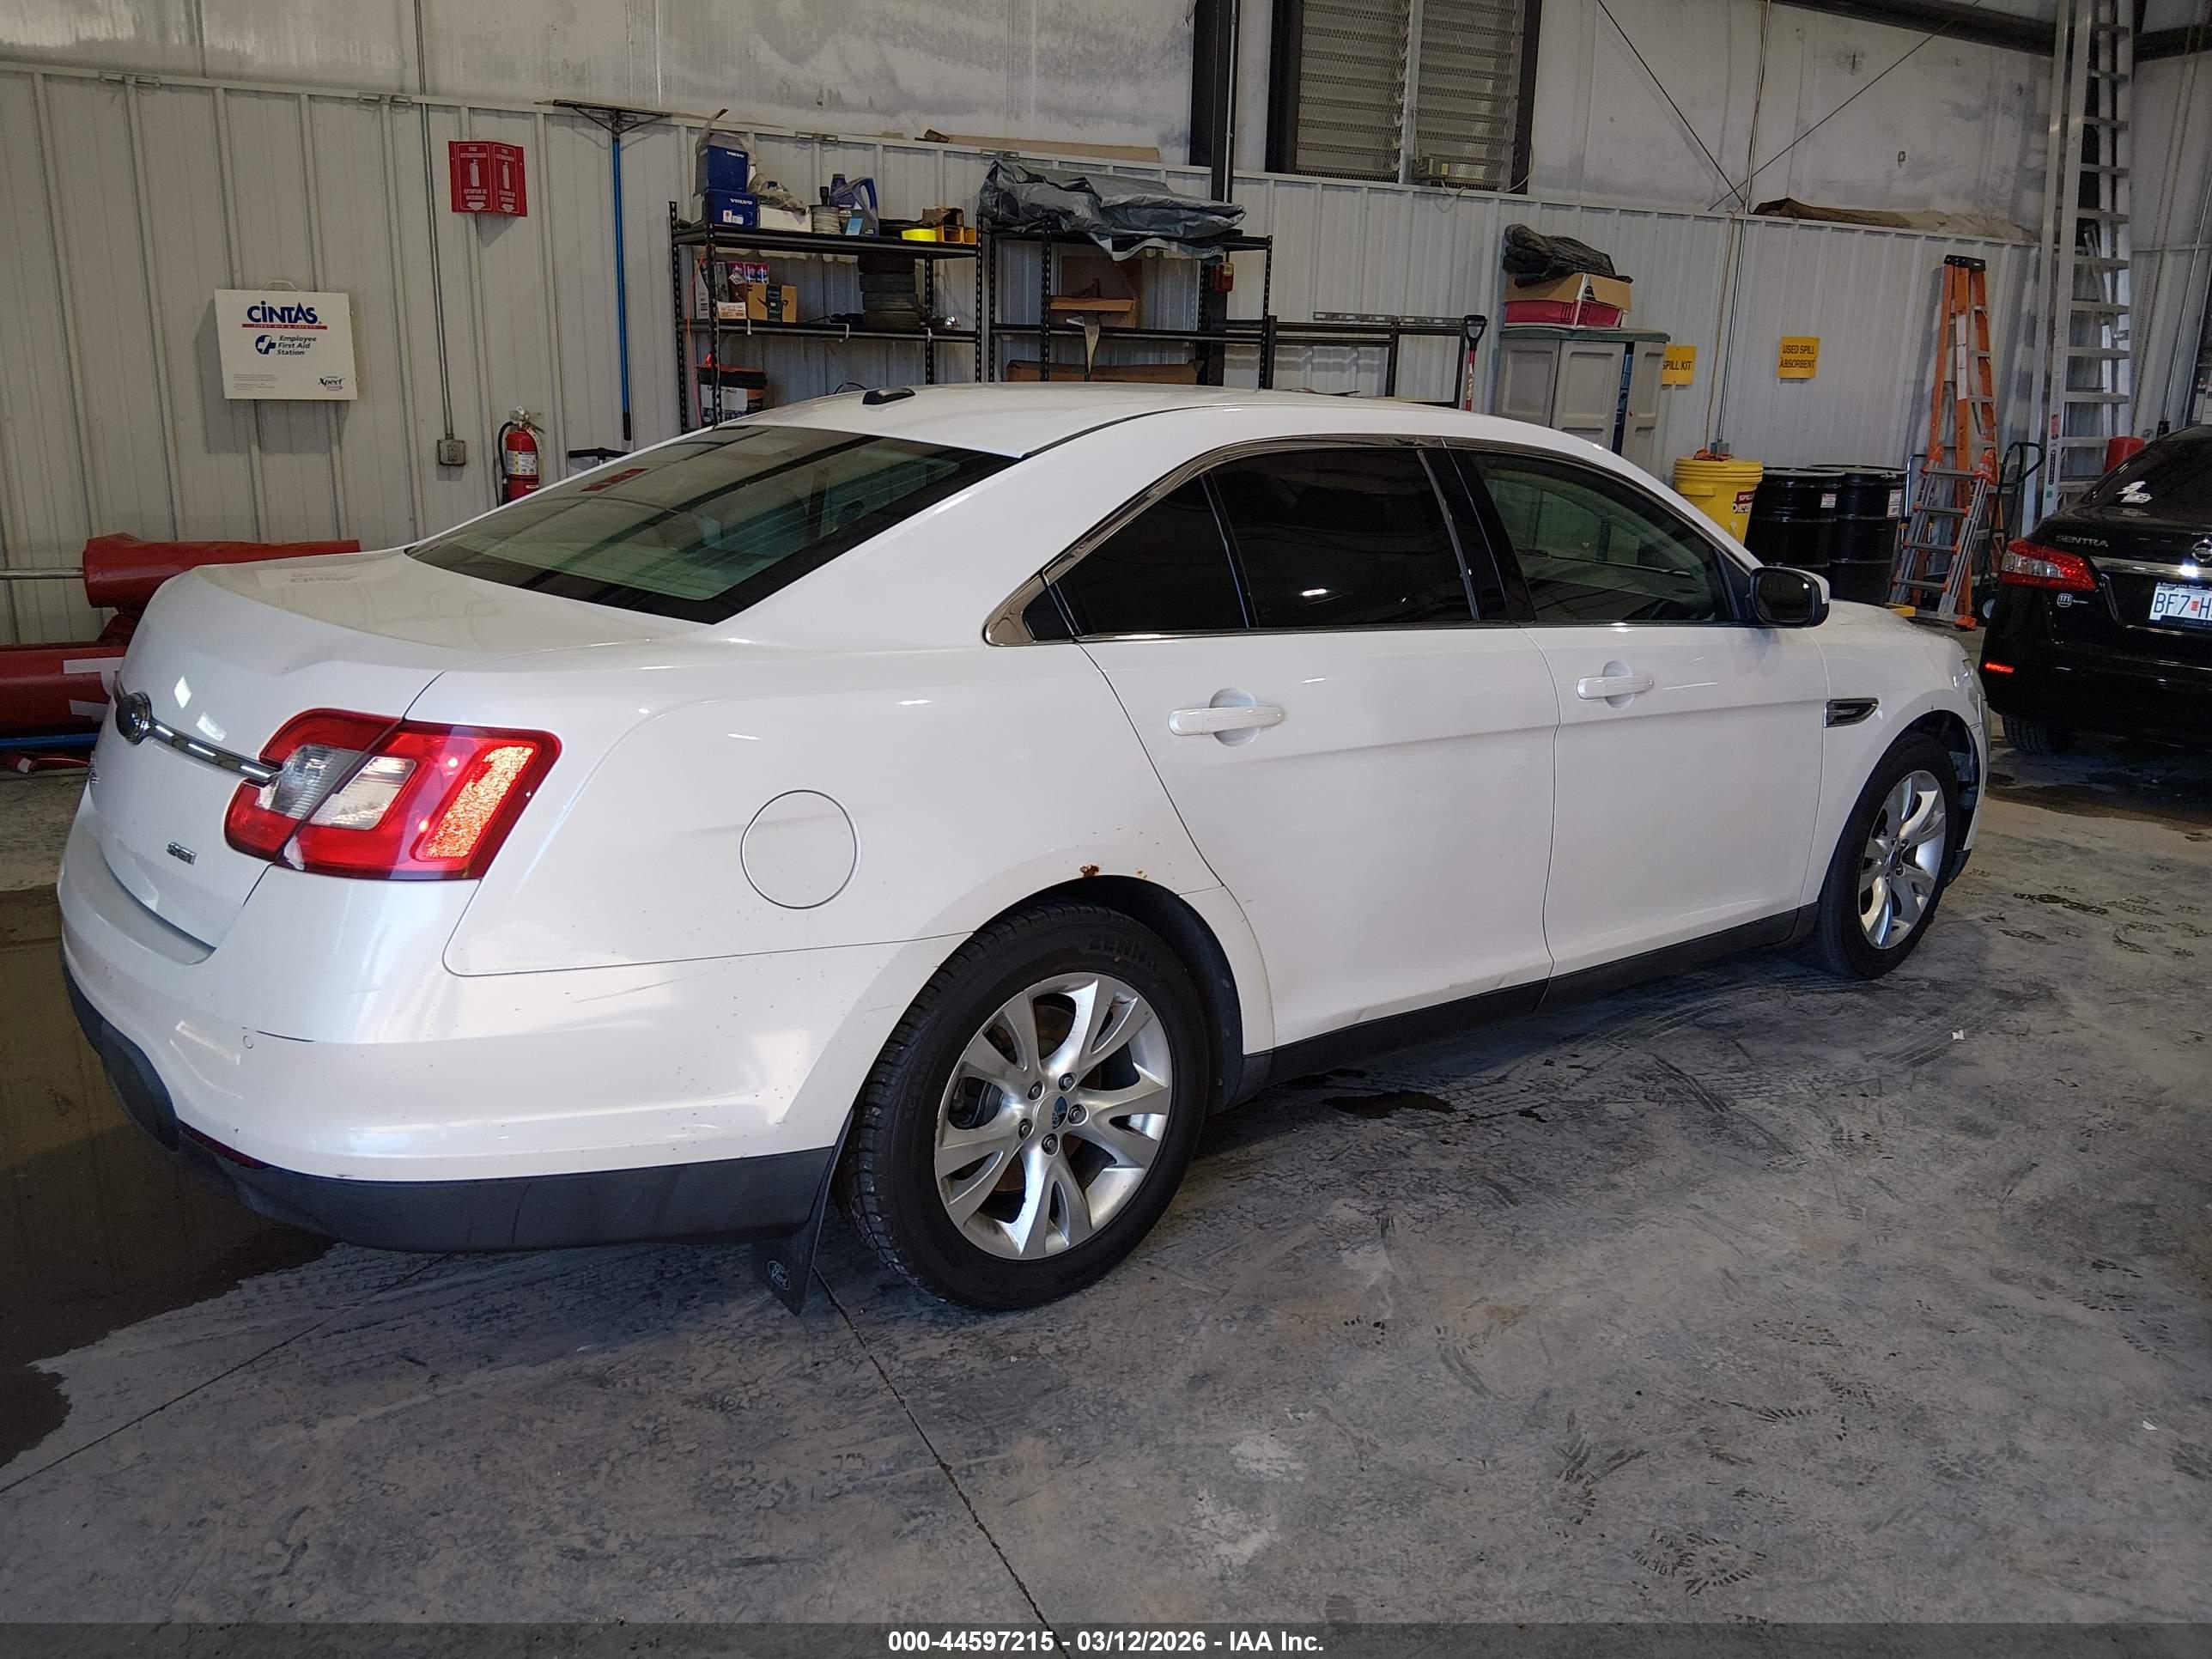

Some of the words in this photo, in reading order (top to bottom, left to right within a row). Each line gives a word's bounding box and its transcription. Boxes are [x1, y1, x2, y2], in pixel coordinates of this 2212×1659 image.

[279, 335, 317, 343] Employee
[1783, 344, 1799, 354] USED
[1799, 345, 1815, 354] SPILL
[1680, 361, 1692, 370] KIT
[1779, 358, 1816, 368] ABSORBENT
[2056, 535, 2109, 547] SENTRA
[2153, 592, 2191, 615] BF7
[2198, 598, 2212, 619] H
